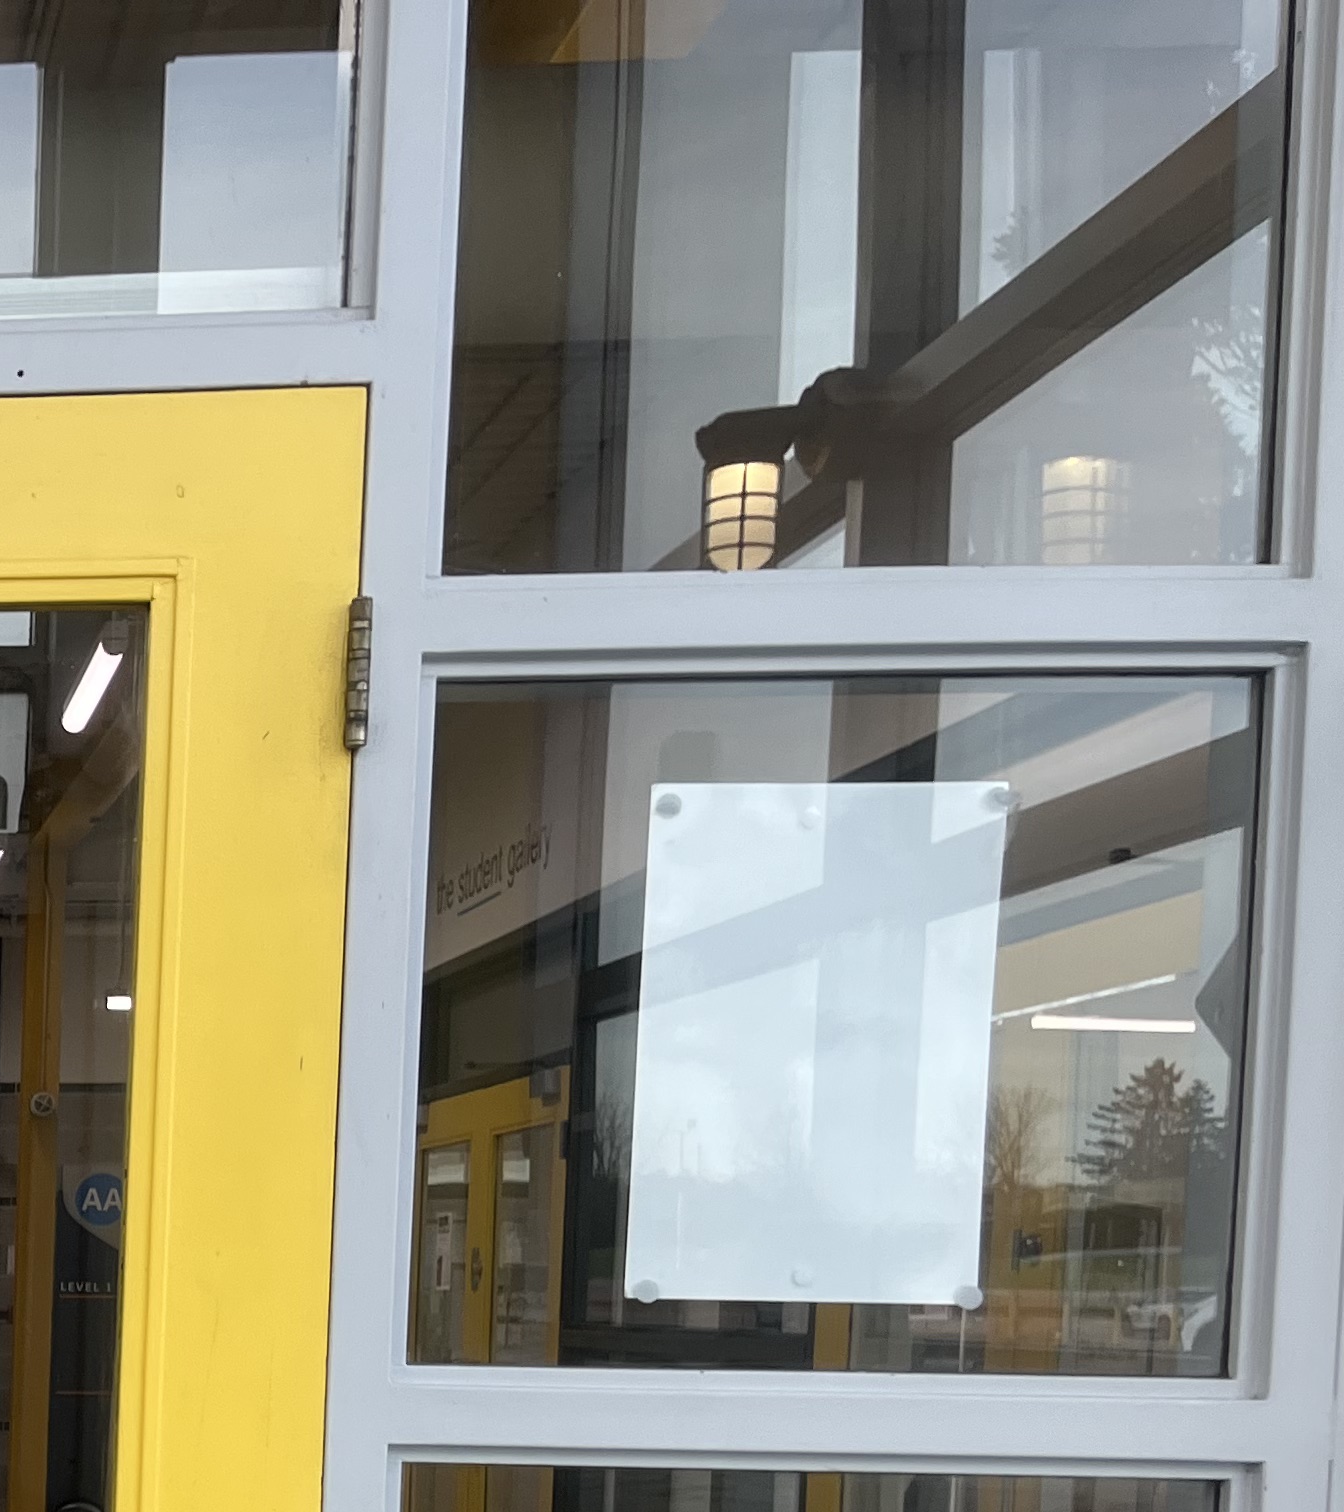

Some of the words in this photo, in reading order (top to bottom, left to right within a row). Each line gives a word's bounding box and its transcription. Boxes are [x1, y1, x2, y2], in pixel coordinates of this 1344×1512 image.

[437, 870, 454, 915] the
[458, 845, 503, 903] student
[507, 823, 551, 888] gallery
[82, 1187, 123, 1212] AA
[60, 1282, 99, 1293] LEVEL
